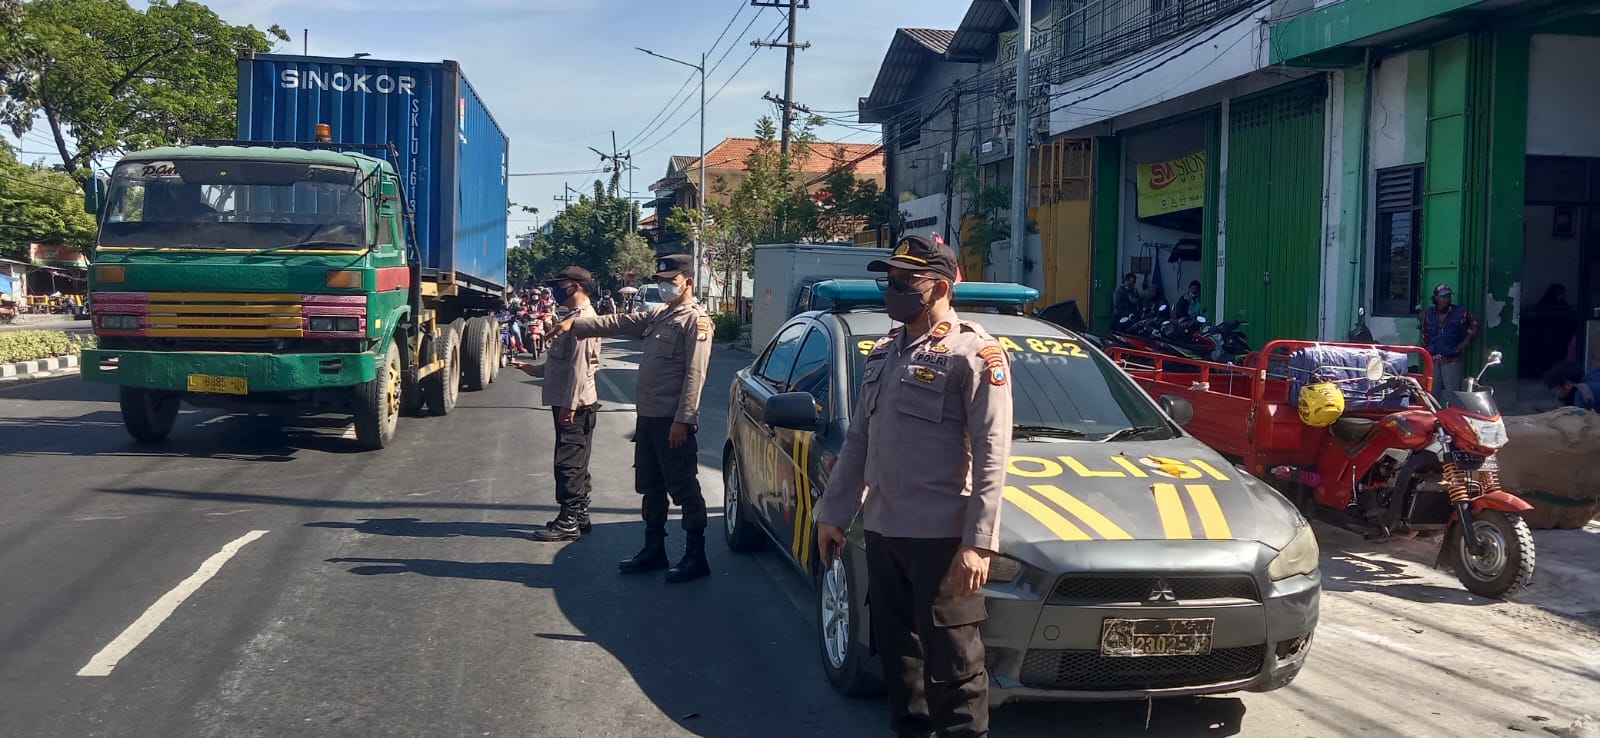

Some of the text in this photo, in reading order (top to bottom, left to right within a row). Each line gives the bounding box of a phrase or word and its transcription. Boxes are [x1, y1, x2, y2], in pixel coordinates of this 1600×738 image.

[281, 69, 416, 96] SINOKOR
[409, 98, 419, 155] SKLU
[917, 353, 947, 367] POLRI
[1026, 338, 1089, 358] 822
[1006, 455, 1231, 481] OLISI
